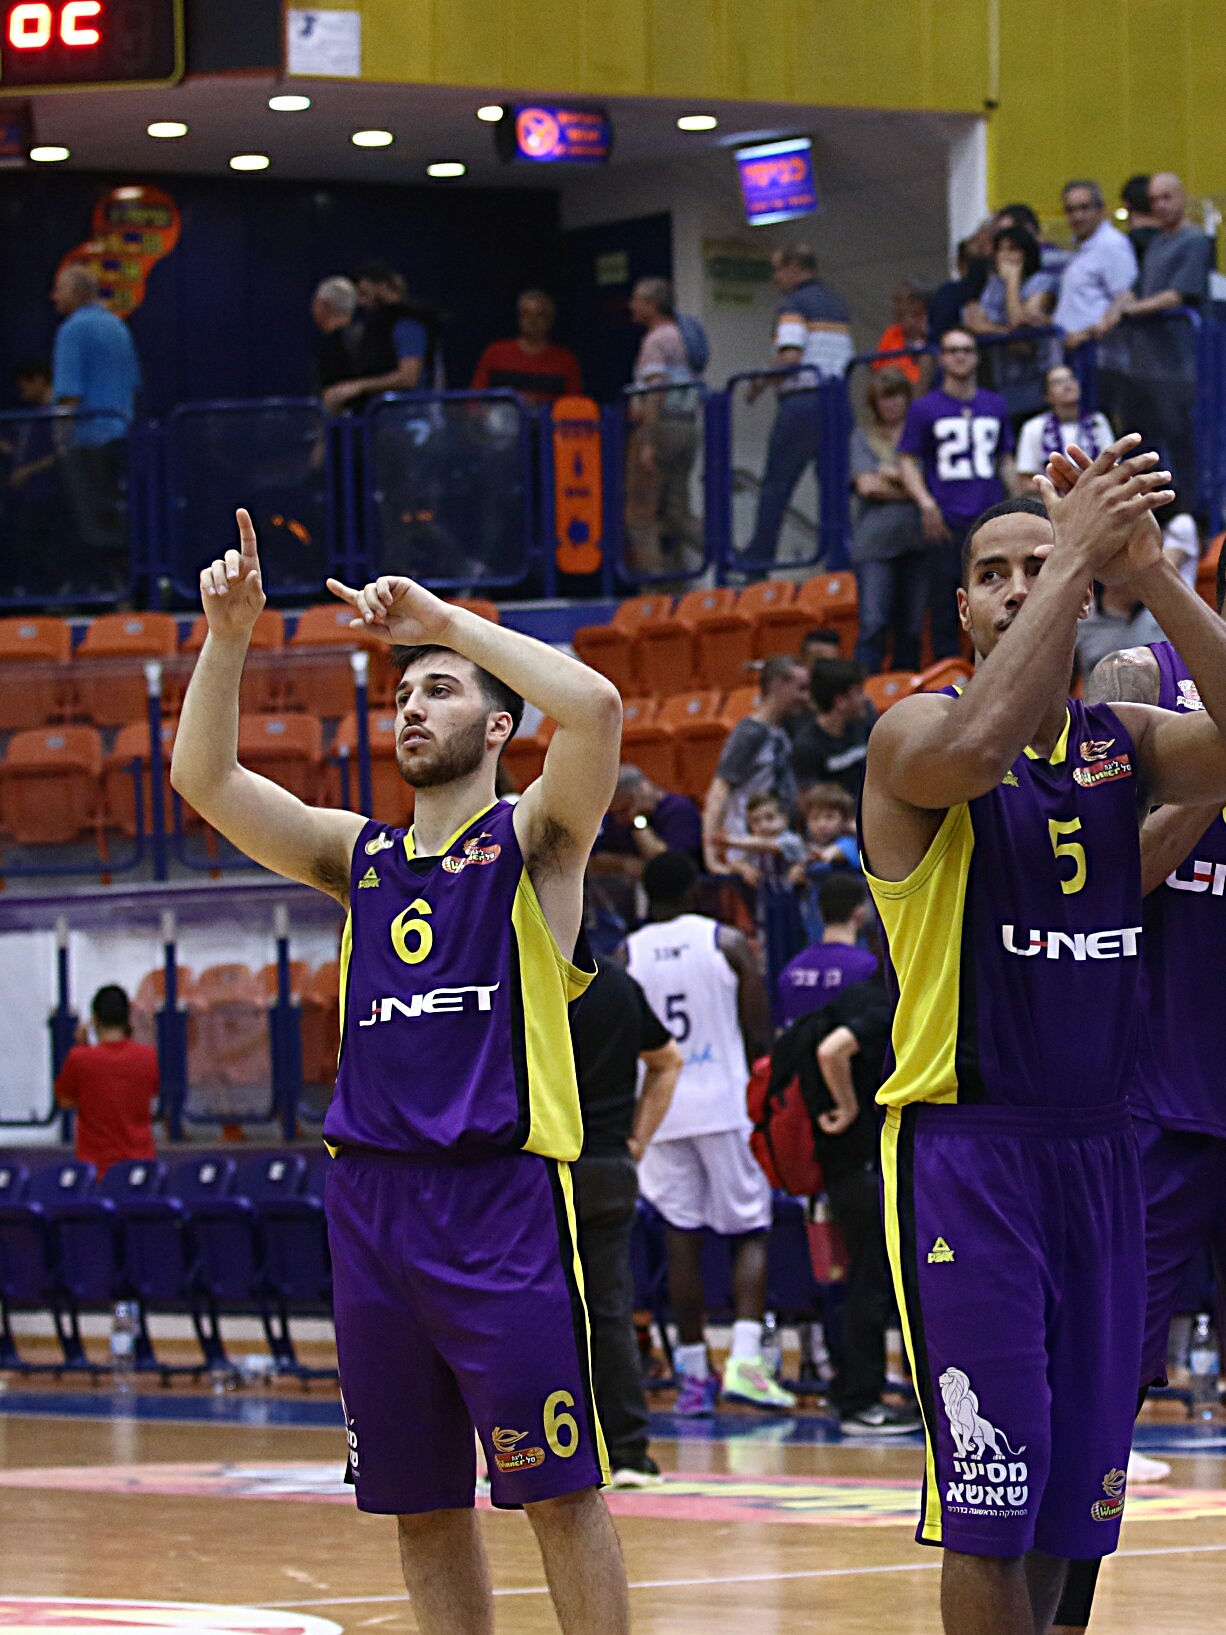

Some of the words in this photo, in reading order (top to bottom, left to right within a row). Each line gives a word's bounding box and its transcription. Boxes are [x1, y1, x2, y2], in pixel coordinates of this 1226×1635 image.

[1048, 817, 1087, 895] 5
[391, 898, 433, 965] 6
[665, 993, 691, 1042] 5
[543, 1390, 579, 1458] 6
[946, 1482, 1028, 1506] שאשא
[953, 1460, 1028, 1483] מסיעי
[999, 1508, 1028, 1519] המחלקה
